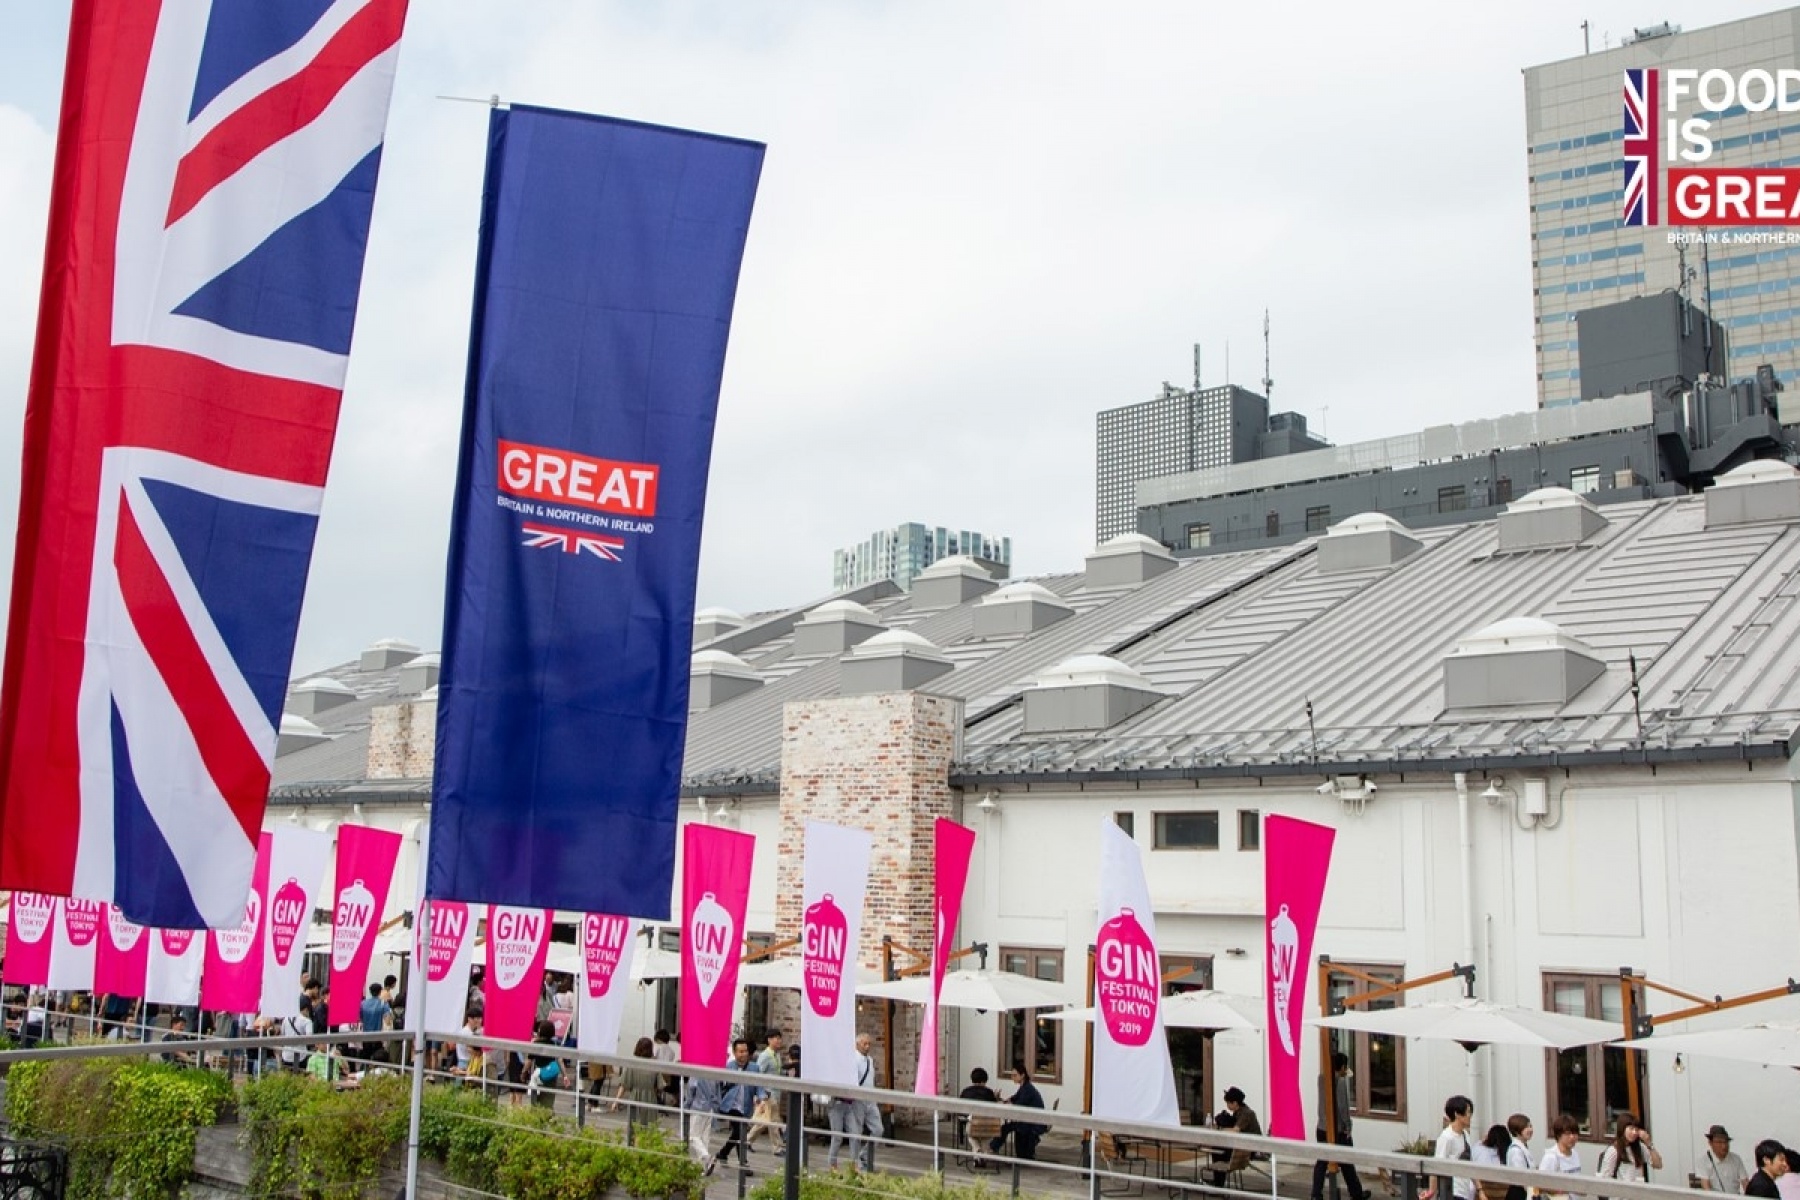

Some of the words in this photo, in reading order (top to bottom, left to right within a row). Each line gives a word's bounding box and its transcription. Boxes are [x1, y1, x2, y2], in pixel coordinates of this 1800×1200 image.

[503, 449, 655, 510] GREAT
[497, 495, 534, 515] BRITAIN
[536, 507, 544, 517] &
[546, 508, 609, 528] NORTHERN
[611, 518, 655, 534] IRELAND
[274, 900, 304, 925] GIN
[337, 902, 370, 928] GIN
[221, 932, 248, 944] TOKYO
[497, 912, 540, 943] GIN
[586, 914, 625, 949] GIN
[428, 947, 451, 961] OKYO
[496, 942, 533, 956] FESTIVAL
[804, 923, 843, 961] GIN
[500, 956, 526, 967] TOKYO
[804, 959, 842, 977] FESTIVAL
[1100, 938, 1156, 989] GIN
[811, 975, 837, 991] TOKYO
[1101, 981, 1156, 1006] FESTIVAL
[1110, 998, 1150, 1019] TOKYO
[1118, 1022, 1142, 1036] 2019
